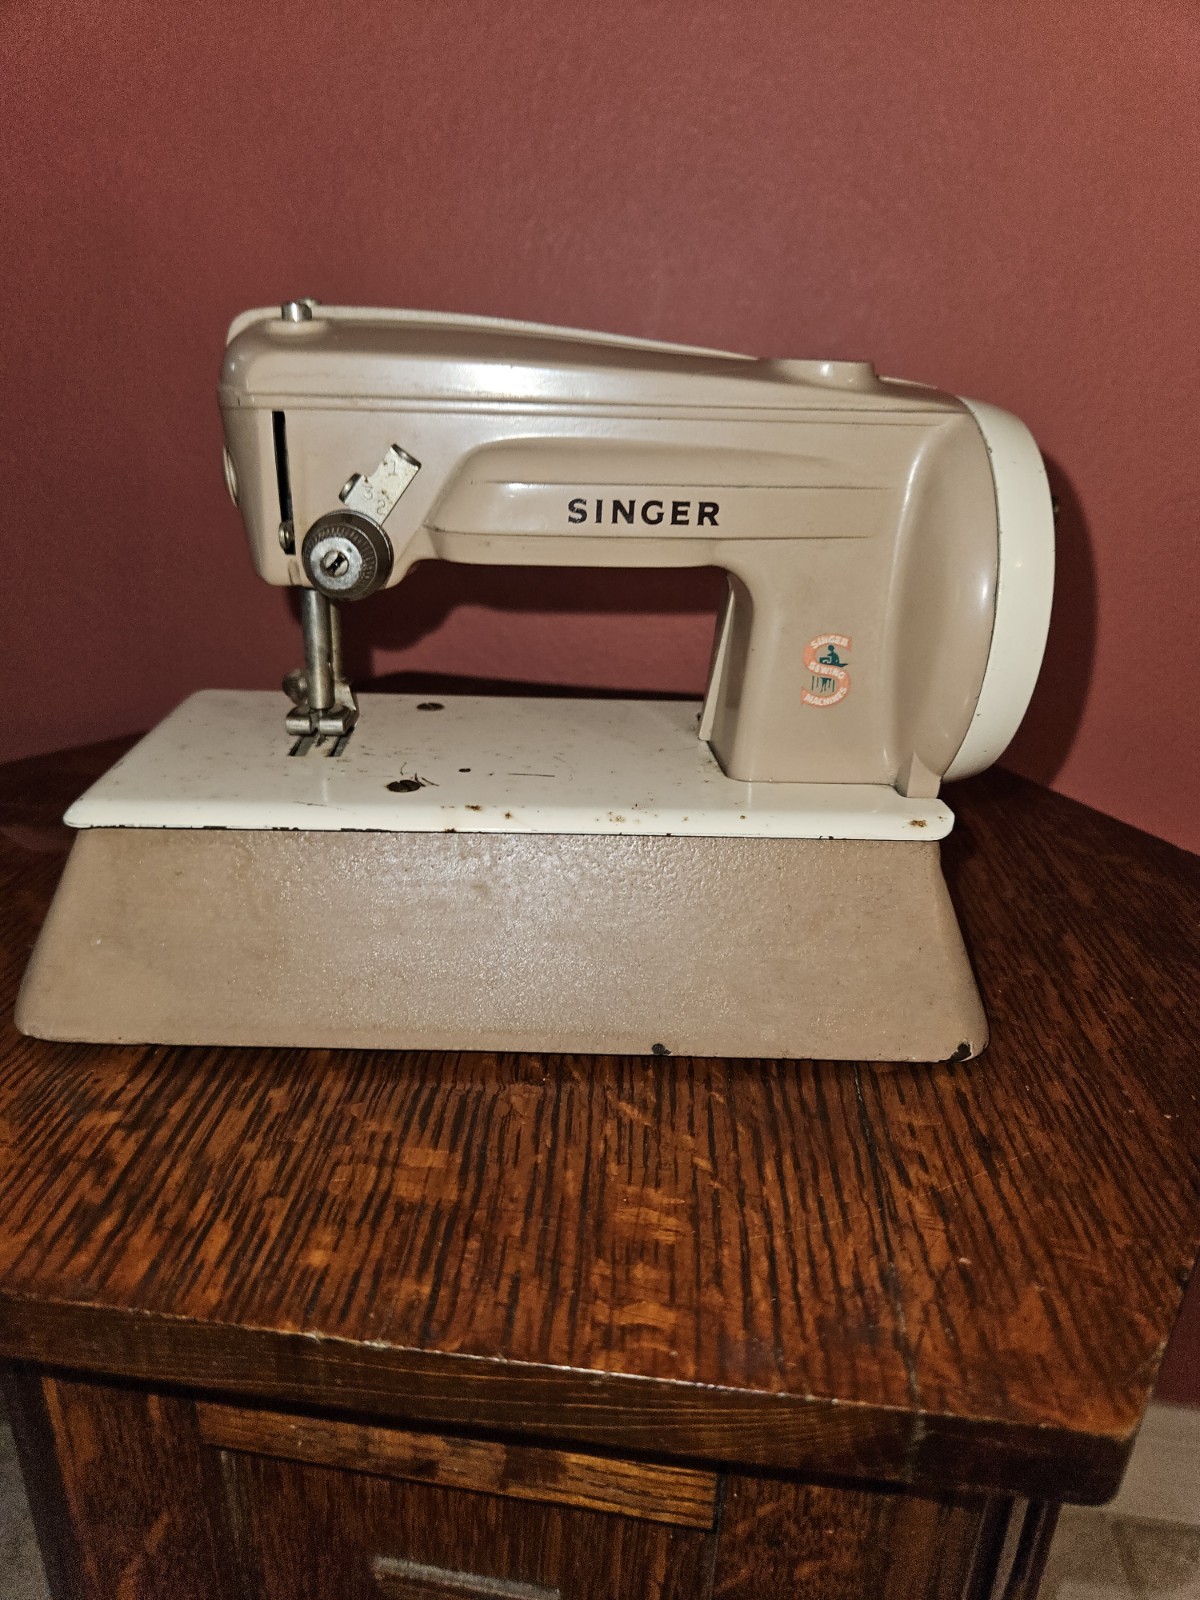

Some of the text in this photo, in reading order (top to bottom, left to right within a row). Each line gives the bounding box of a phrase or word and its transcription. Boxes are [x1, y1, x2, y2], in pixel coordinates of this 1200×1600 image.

[567, 498, 720, 527] SINGER
[810, 635, 849, 650] SINGER
[808, 661, 846, 680] SEWING
[803, 686, 848, 706] MACHINES
